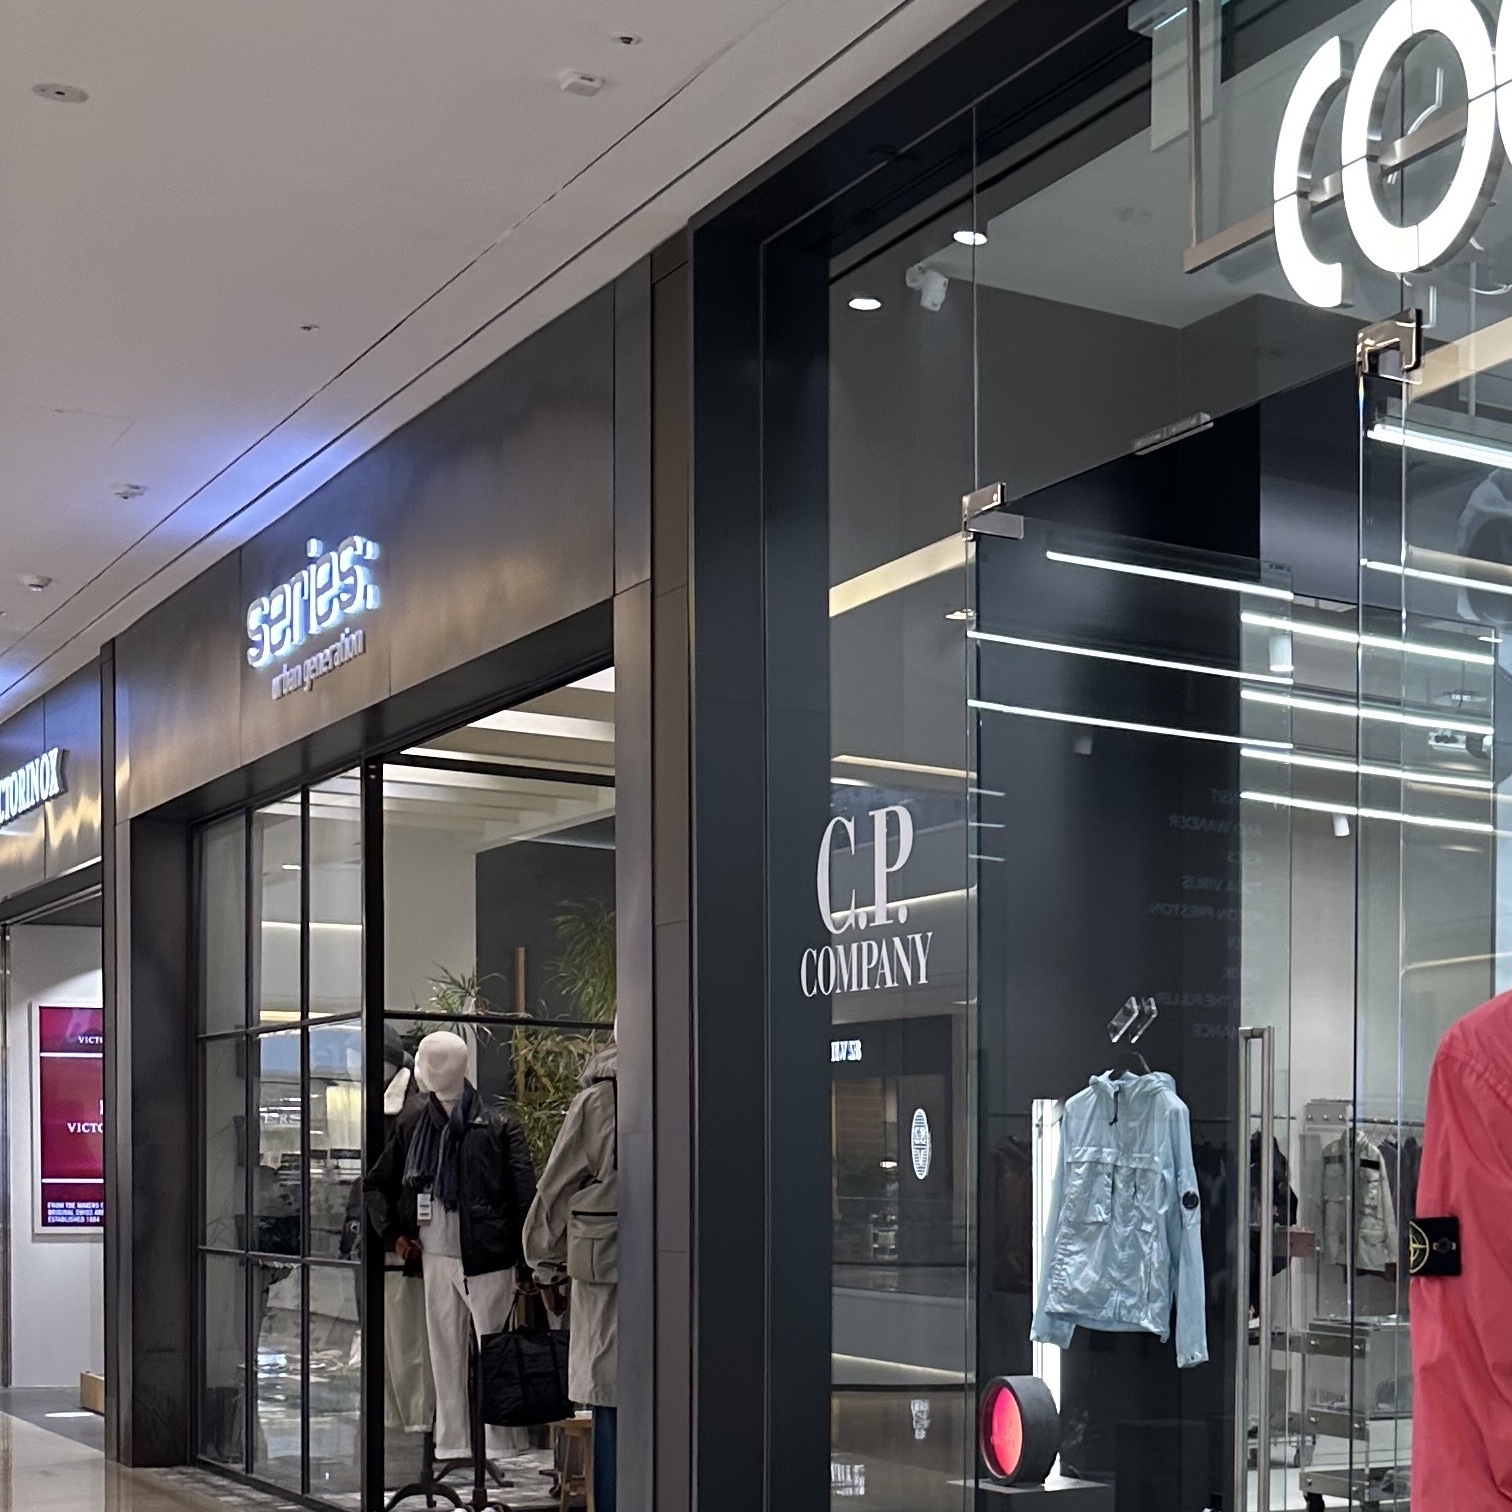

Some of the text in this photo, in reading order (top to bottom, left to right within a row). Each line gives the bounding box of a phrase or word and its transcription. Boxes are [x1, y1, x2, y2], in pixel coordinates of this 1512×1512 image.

[303, 627, 365, 692] generation
[816, 805, 914, 935] C.P.
[800, 931, 933, 998] COMPANY
